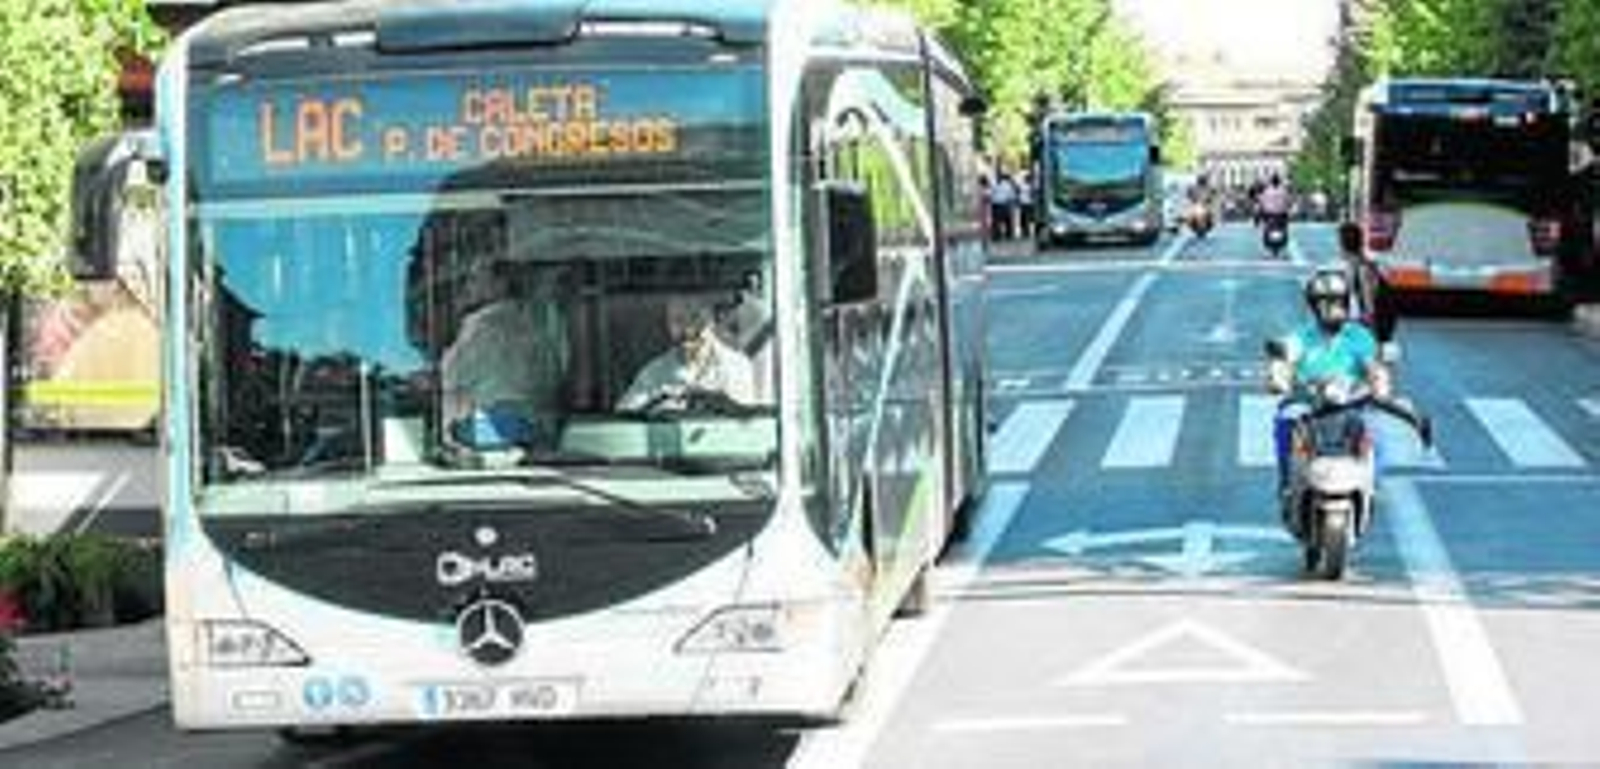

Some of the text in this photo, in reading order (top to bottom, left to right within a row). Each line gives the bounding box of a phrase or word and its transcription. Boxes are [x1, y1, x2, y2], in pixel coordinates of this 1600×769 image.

[464, 87, 597, 122] CALETA
[262, 98, 364, 163] LAC
[426, 126, 467, 161] DE
[479, 119, 678, 157] CONGRESOS
